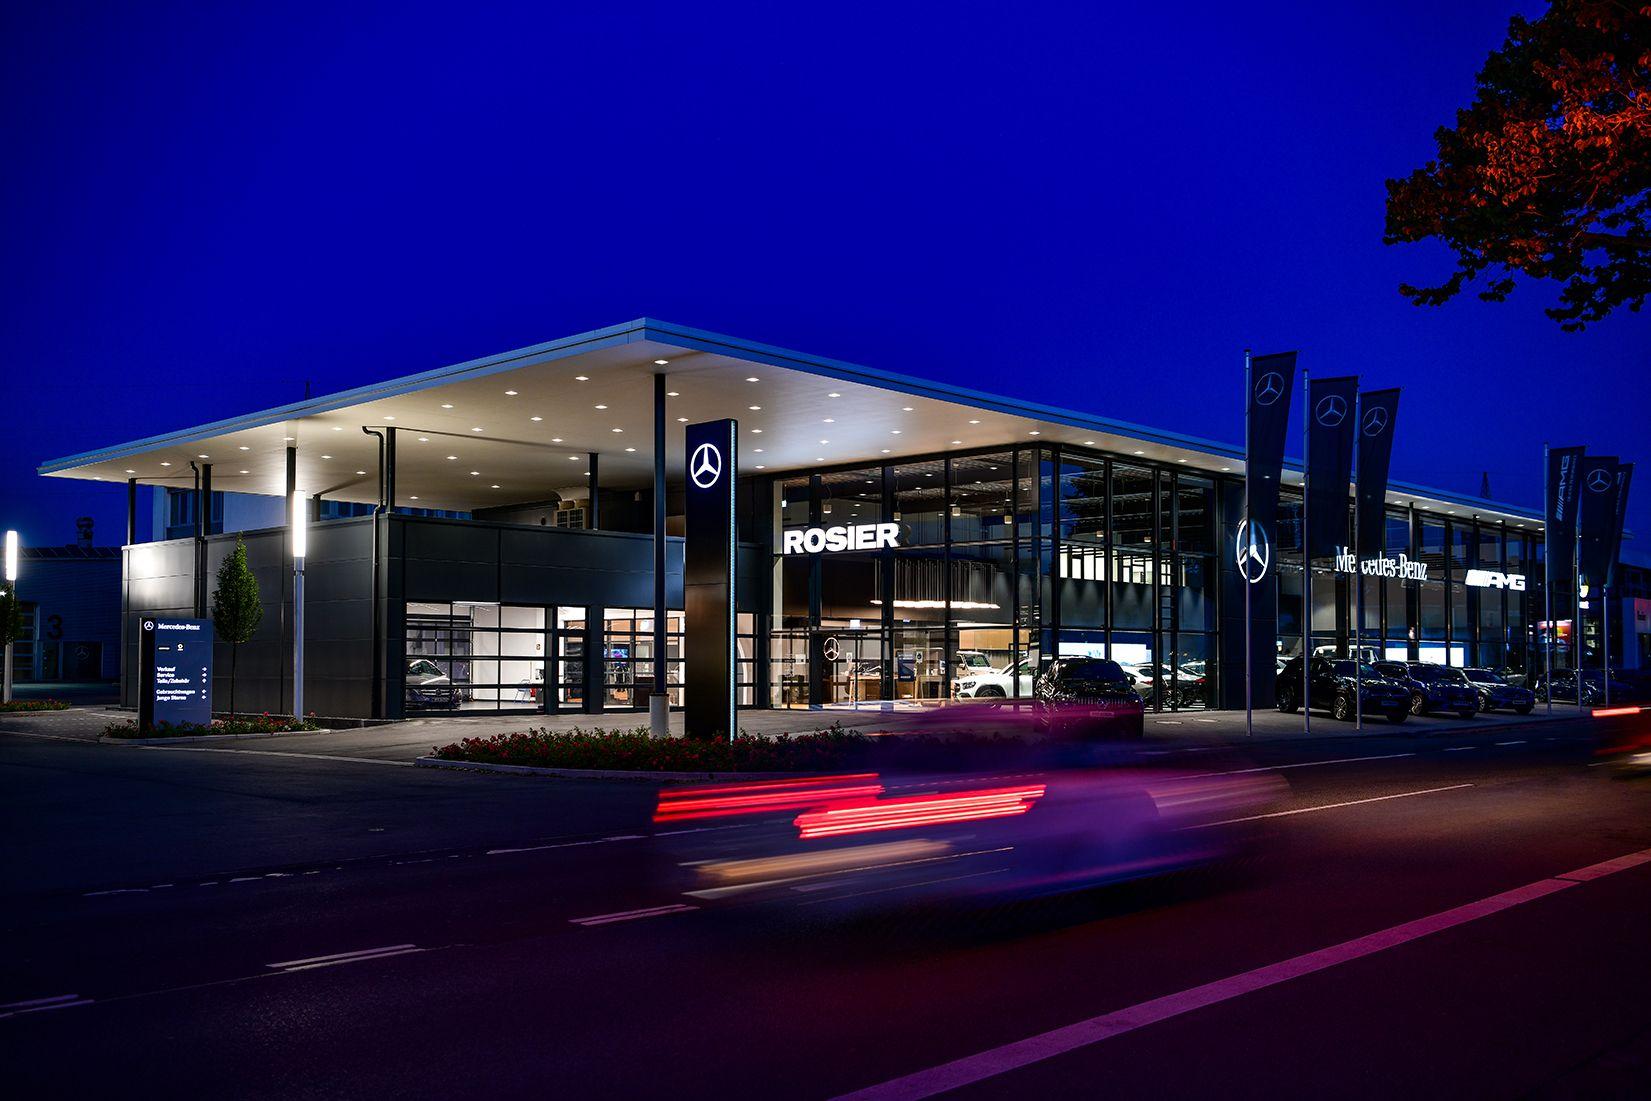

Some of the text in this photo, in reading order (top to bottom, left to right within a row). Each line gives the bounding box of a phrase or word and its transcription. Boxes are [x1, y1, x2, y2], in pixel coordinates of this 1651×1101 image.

[784, 523, 899, 554] ROSIER
[1335, 546, 1427, 580] Mecedes-Benz
[48, 614, 63, 640] 3
